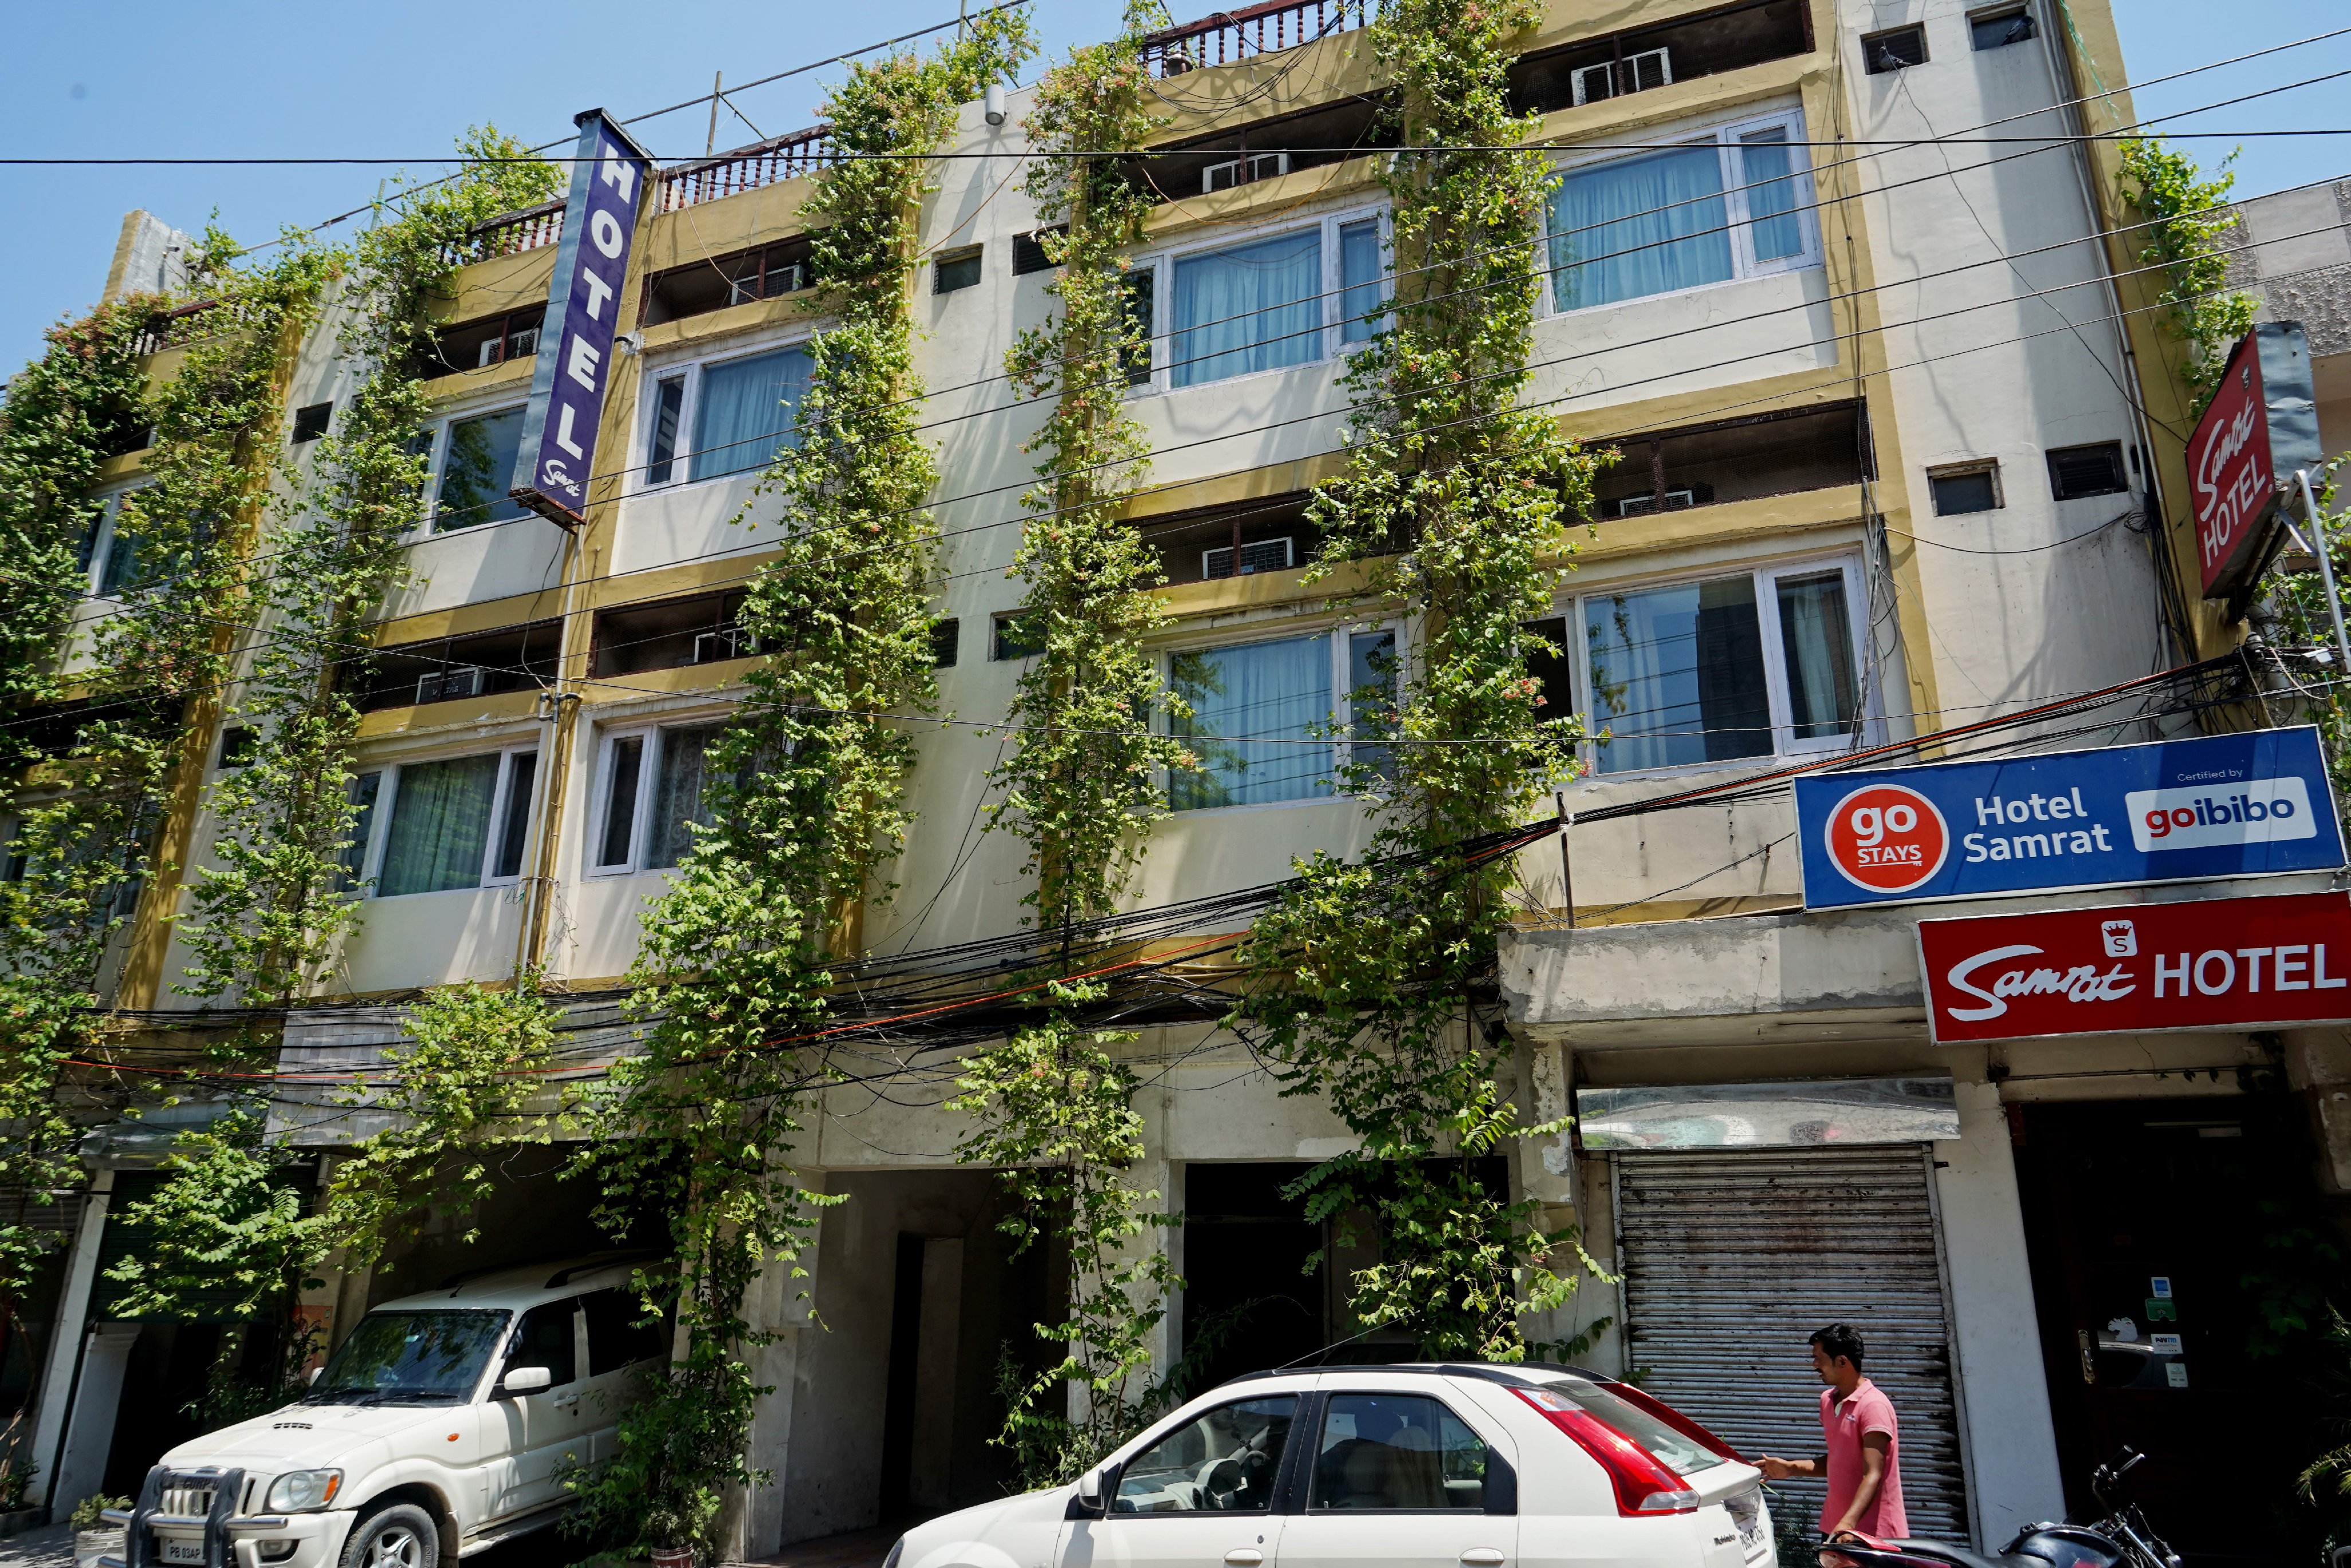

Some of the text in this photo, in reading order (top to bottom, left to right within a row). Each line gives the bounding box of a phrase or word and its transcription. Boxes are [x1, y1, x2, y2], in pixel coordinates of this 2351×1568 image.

[556, 143, 635, 460] HOTEL
[542, 459, 580, 497] Samrat
[2197, 396, 2256, 522] Samrat
[2177, 769, 2243, 781] Certified by
[1851, 804, 1917, 847] go
[1975, 787, 2088, 826] Hotel
[2145, 795, 2294, 838] goibibo
[1858, 844, 1922, 864] STAYS
[1963, 823, 2113, 863] Samrat
[2113, 938, 2128, 953] S
[1948, 944, 2346, 1021] Samrat HOTEL
[170, 1547, 180, 1558] PB
